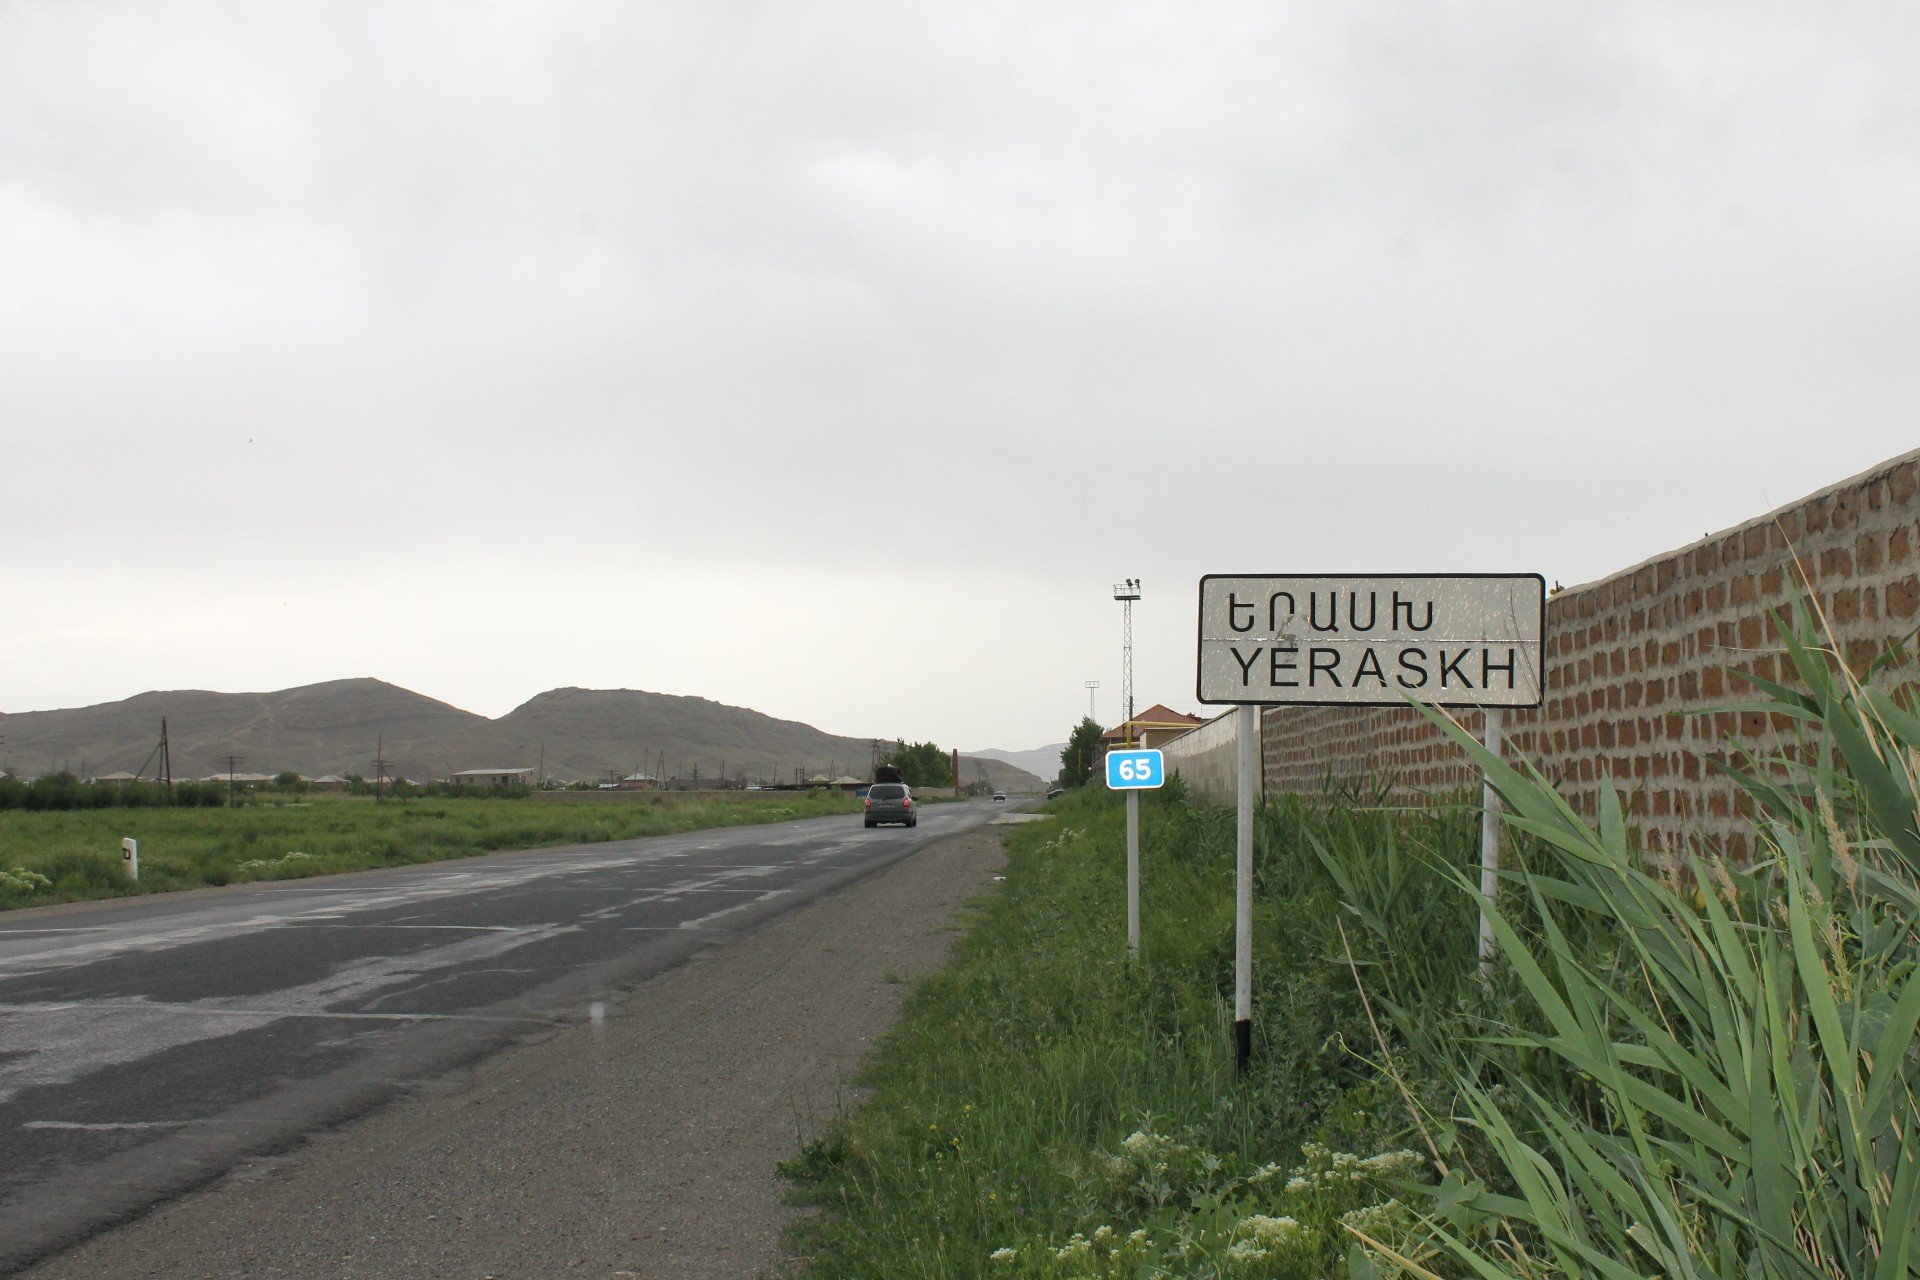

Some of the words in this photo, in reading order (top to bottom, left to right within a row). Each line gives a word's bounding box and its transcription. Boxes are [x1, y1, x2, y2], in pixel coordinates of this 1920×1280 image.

[1229, 591, 1433, 633] ԵՐԱՍԽ
[1229, 647, 1515, 689] YERASKH
[1119, 758, 1151, 781] 65
